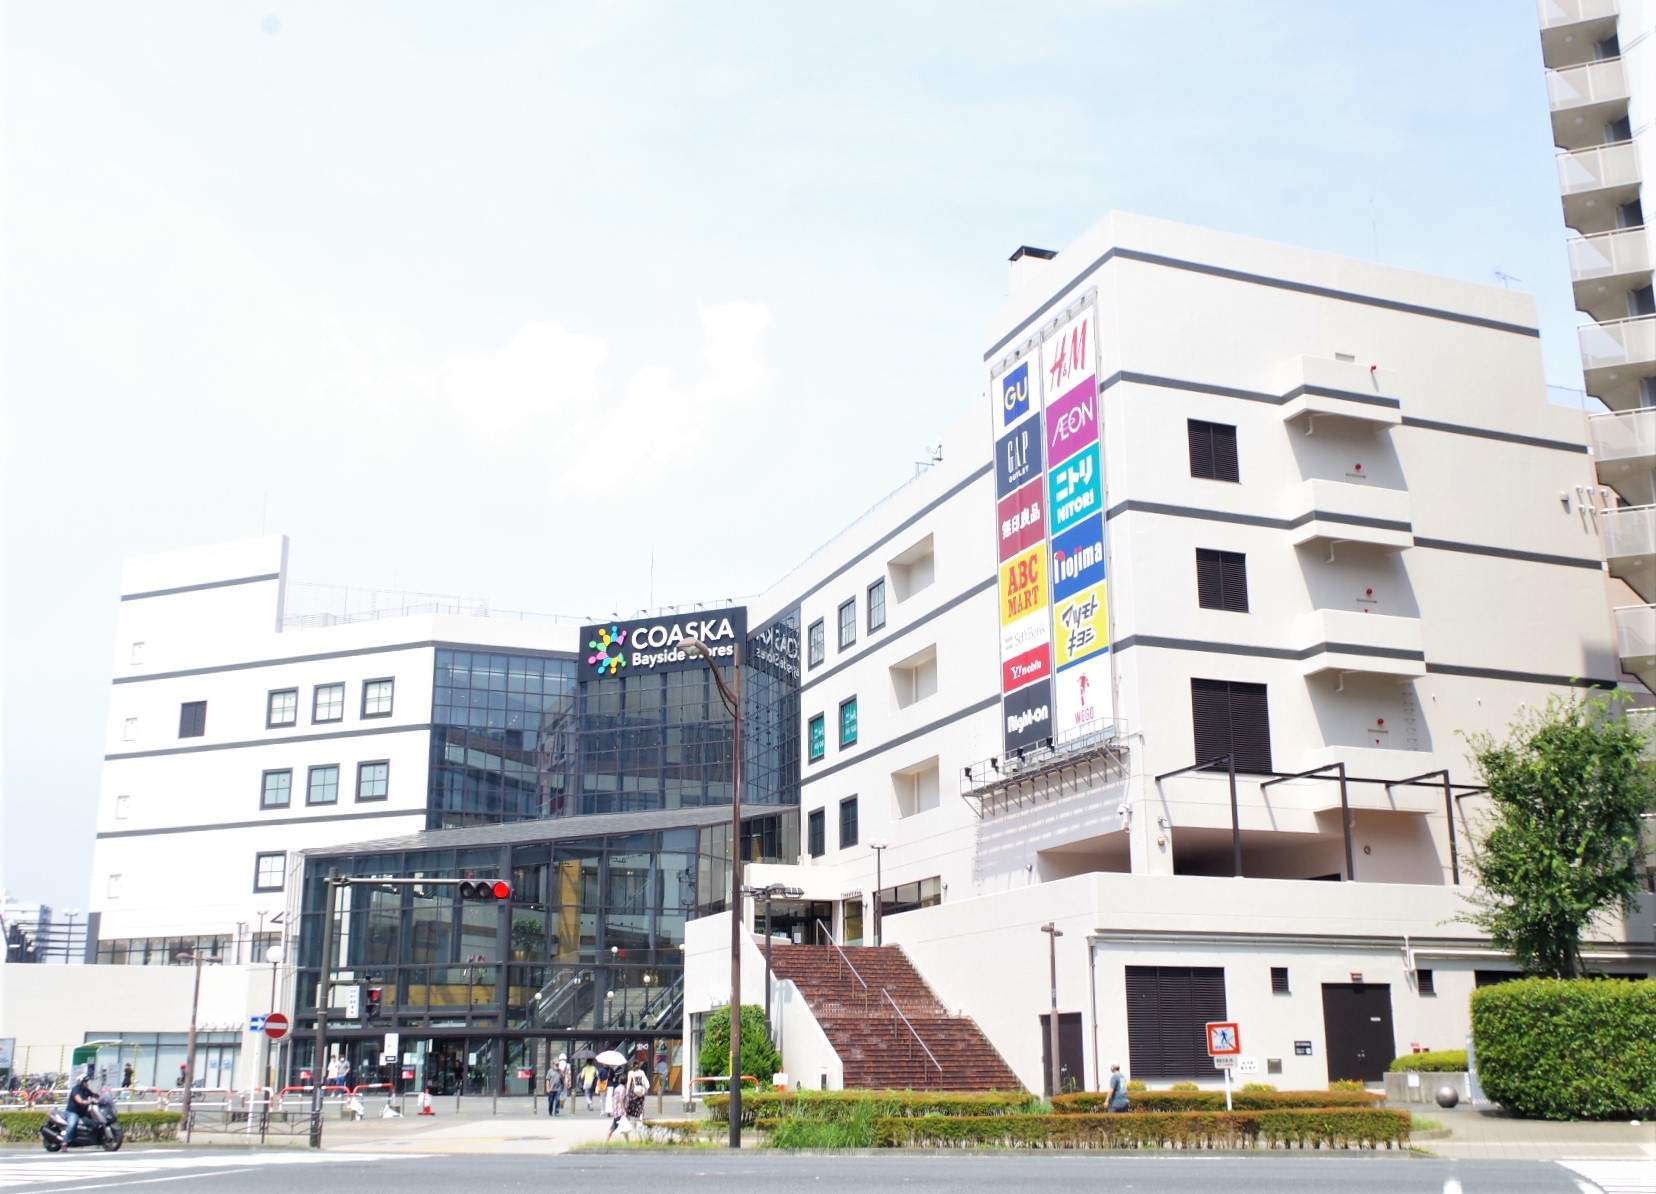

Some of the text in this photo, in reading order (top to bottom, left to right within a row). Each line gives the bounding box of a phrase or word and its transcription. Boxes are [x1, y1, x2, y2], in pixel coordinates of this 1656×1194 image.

[1050, 319, 1088, 392] H&M
[1004, 376, 1028, 410] GU
[1007, 430, 1029, 474] GAP
[1008, 465, 1029, 483] OUTLET
[1055, 454, 1094, 501] ニトリ
[1056, 488, 1095, 525] NITORI
[1007, 553, 1039, 597] ABC
[1008, 585, 1040, 618] MART
[1062, 594, 1099, 629] マツモト
[631, 618, 735, 650] COASKA
[632, 647, 686, 668] Bayside
[1007, 705, 1048, 734] Right-on
[1075, 709, 1095, 725] WEGO
